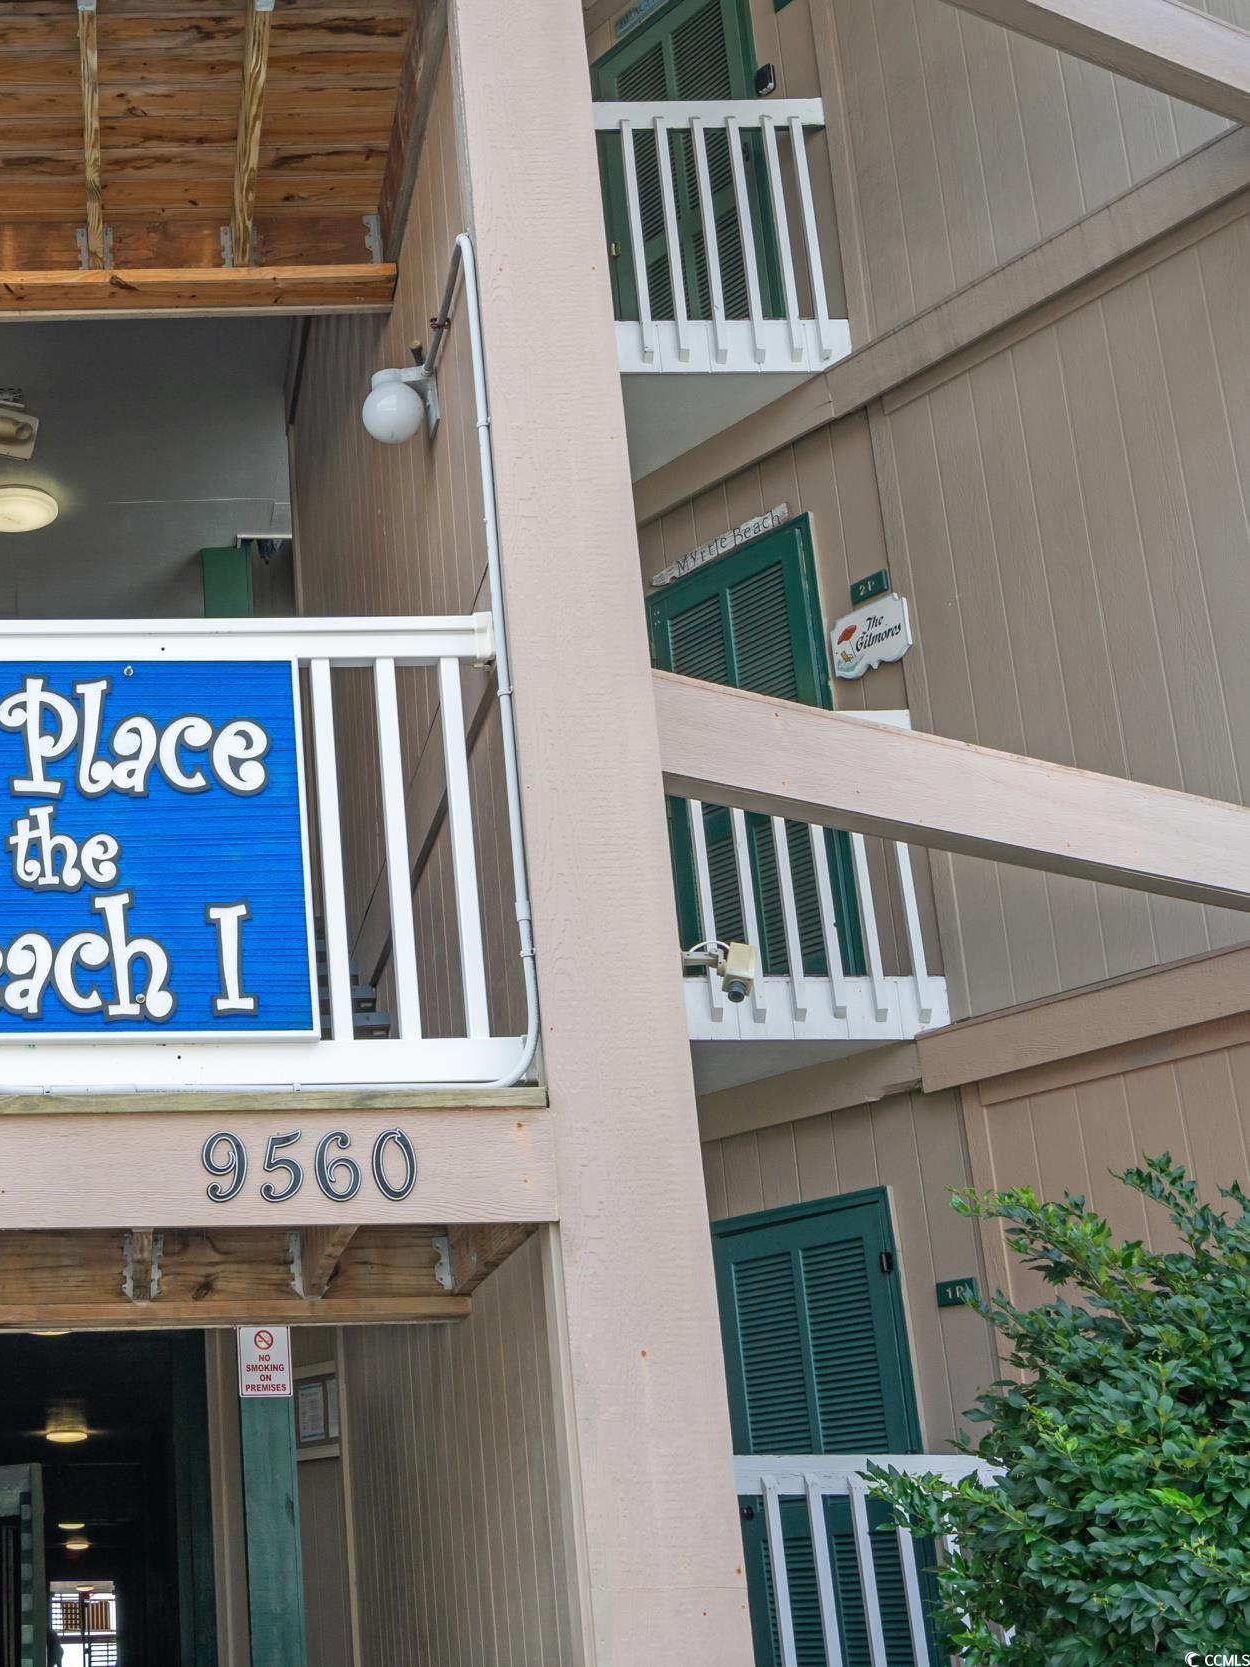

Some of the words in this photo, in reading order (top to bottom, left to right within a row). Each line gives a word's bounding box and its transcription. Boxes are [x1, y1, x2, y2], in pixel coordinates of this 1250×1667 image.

[674, 534, 728, 577] Myrtle
[732, 510, 781, 547] Beach
[862, 615, 884, 635] The
[855, 623, 902, 652] Gilmores
[7, 805, 121, 888] the
[207, 902, 256, 1013] I
[202, 1129, 418, 1203] 9560
[246, 1364, 285, 1372] SMOKING
[258, 1354, 271, 1362] NO
[245, 1383, 287, 1392] PREMISES
[259, 1374, 272, 1382] ON
